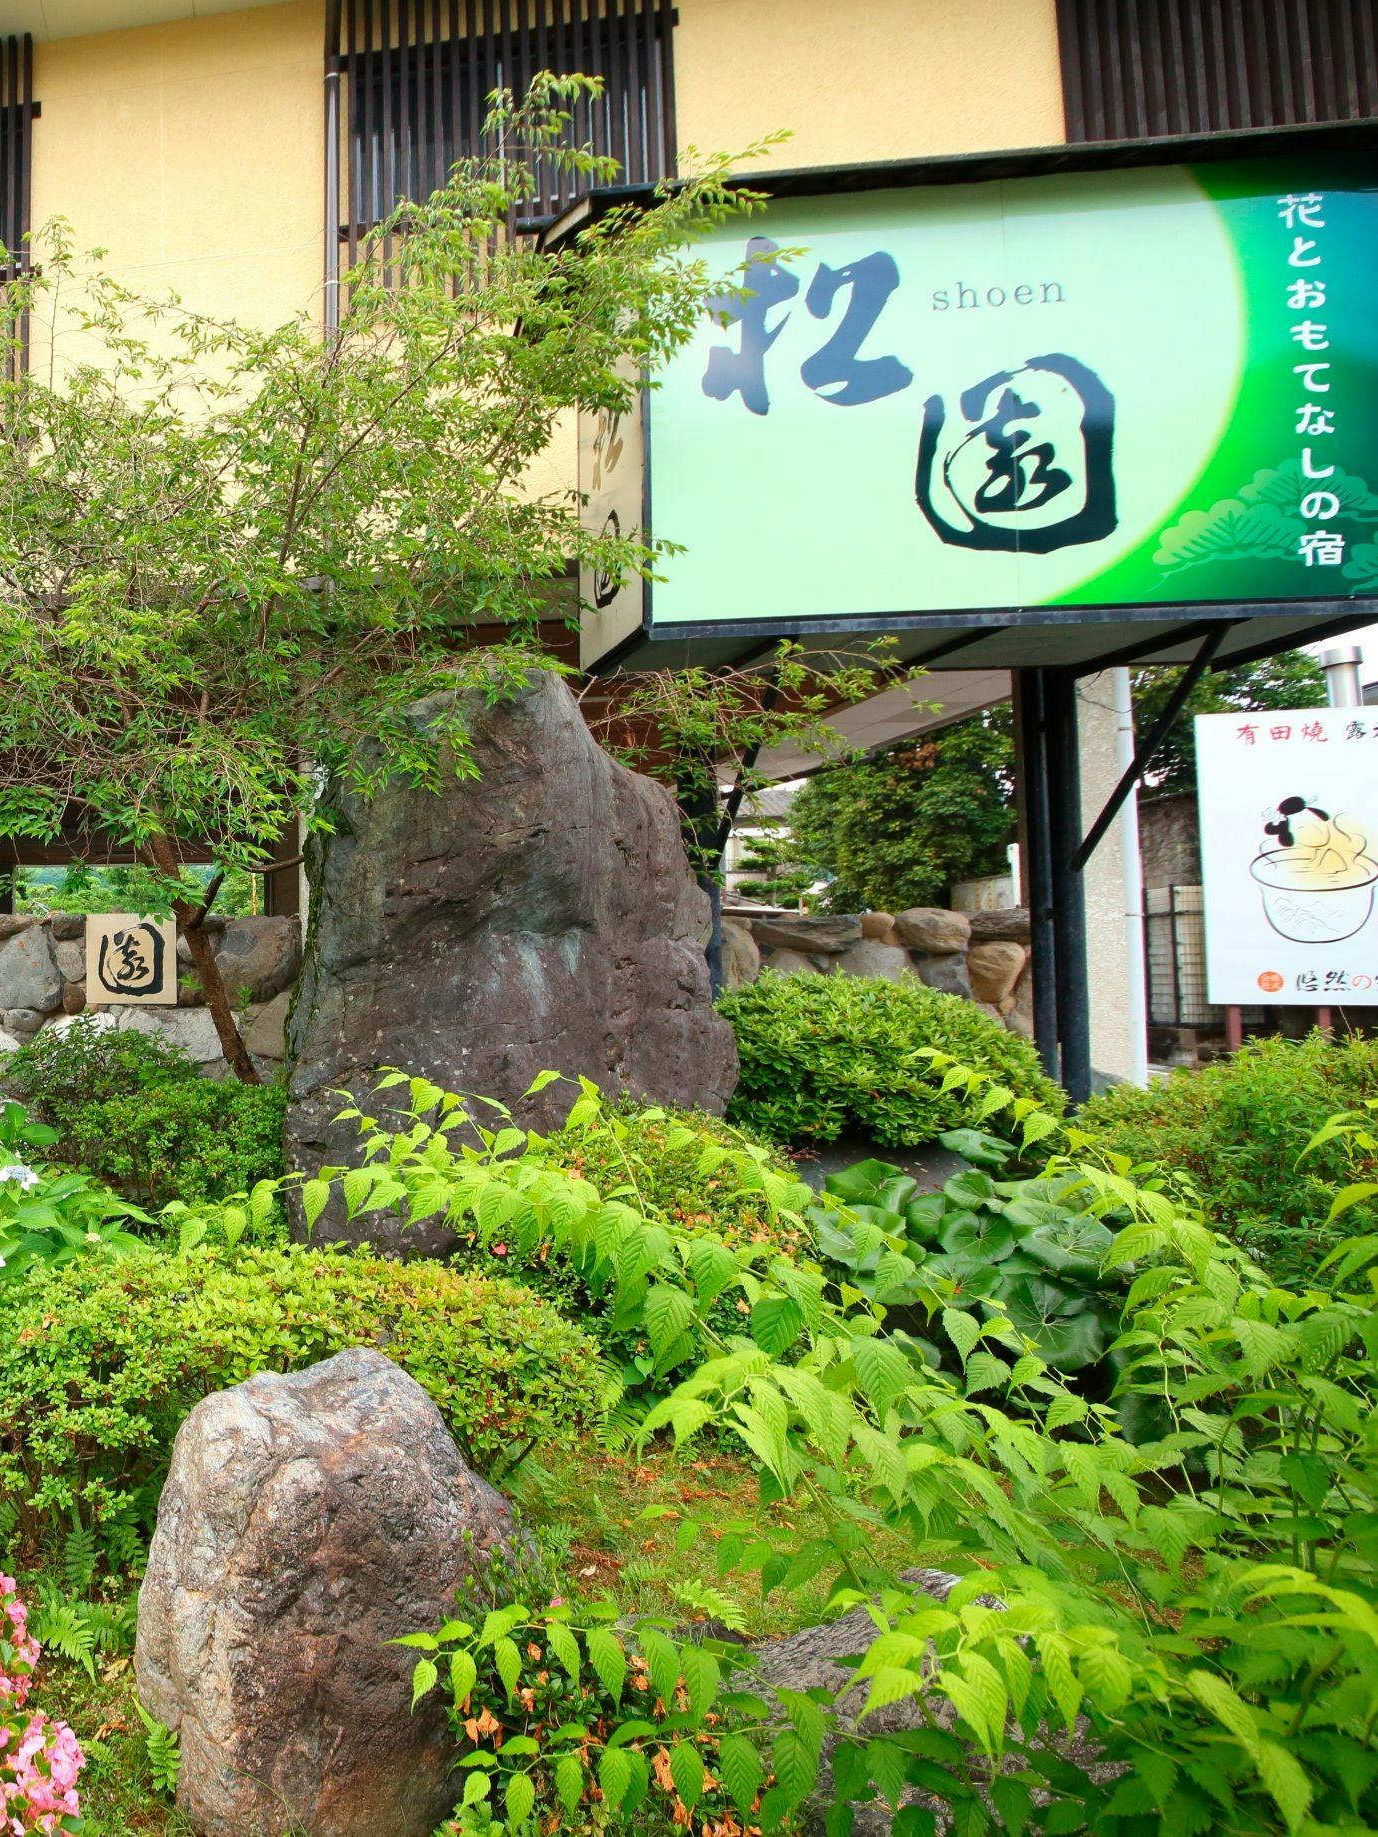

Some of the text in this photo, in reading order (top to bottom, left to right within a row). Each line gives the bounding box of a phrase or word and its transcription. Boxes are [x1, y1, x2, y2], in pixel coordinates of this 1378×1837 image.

[932, 281, 1066, 311] shoen
[1277, 192, 1346, 567] 花とおもてなしの宿
[1345, 720, 1378, 741] 露
[1295, 970, 1378, 993] 悠然の
